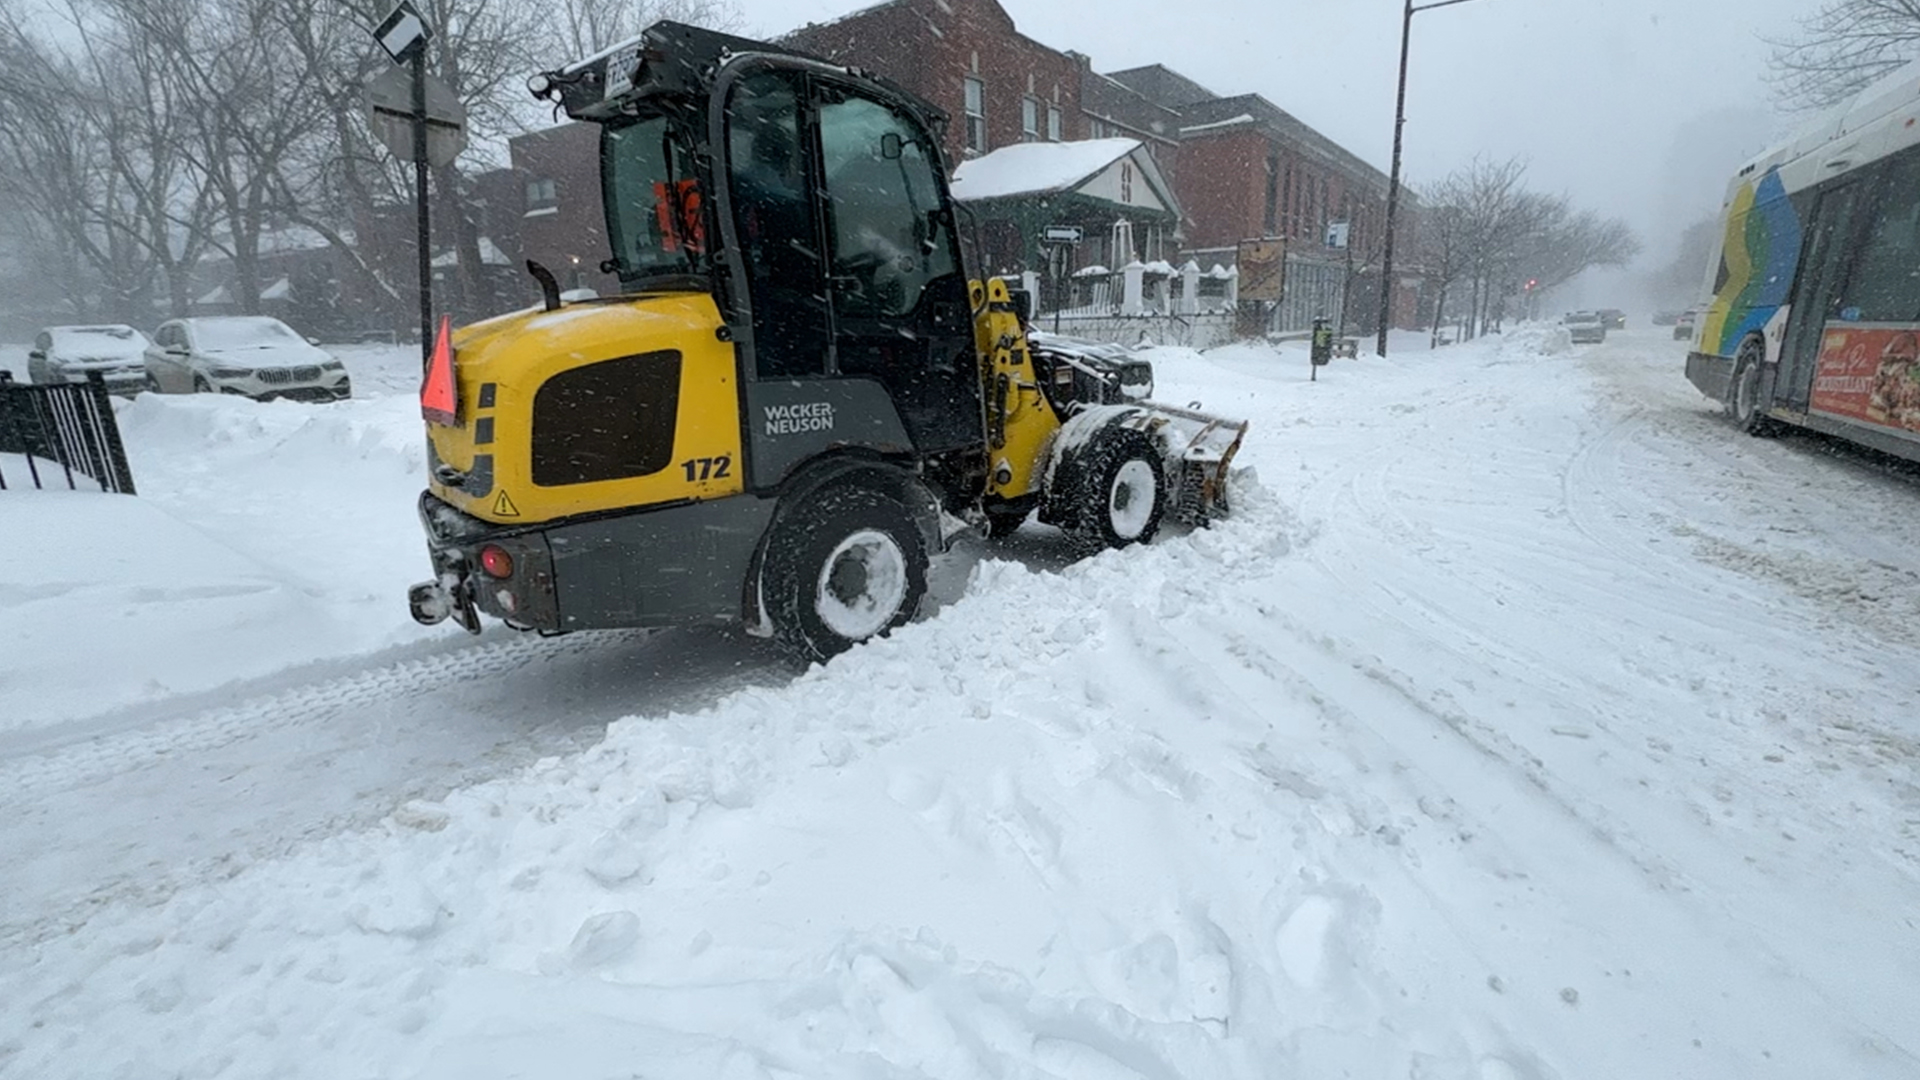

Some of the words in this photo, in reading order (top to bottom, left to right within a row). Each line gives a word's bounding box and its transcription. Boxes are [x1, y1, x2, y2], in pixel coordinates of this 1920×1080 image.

[764, 402, 832, 420] WACKER
[766, 416, 833, 435] NEUSON
[681, 456, 731, 482] 172
